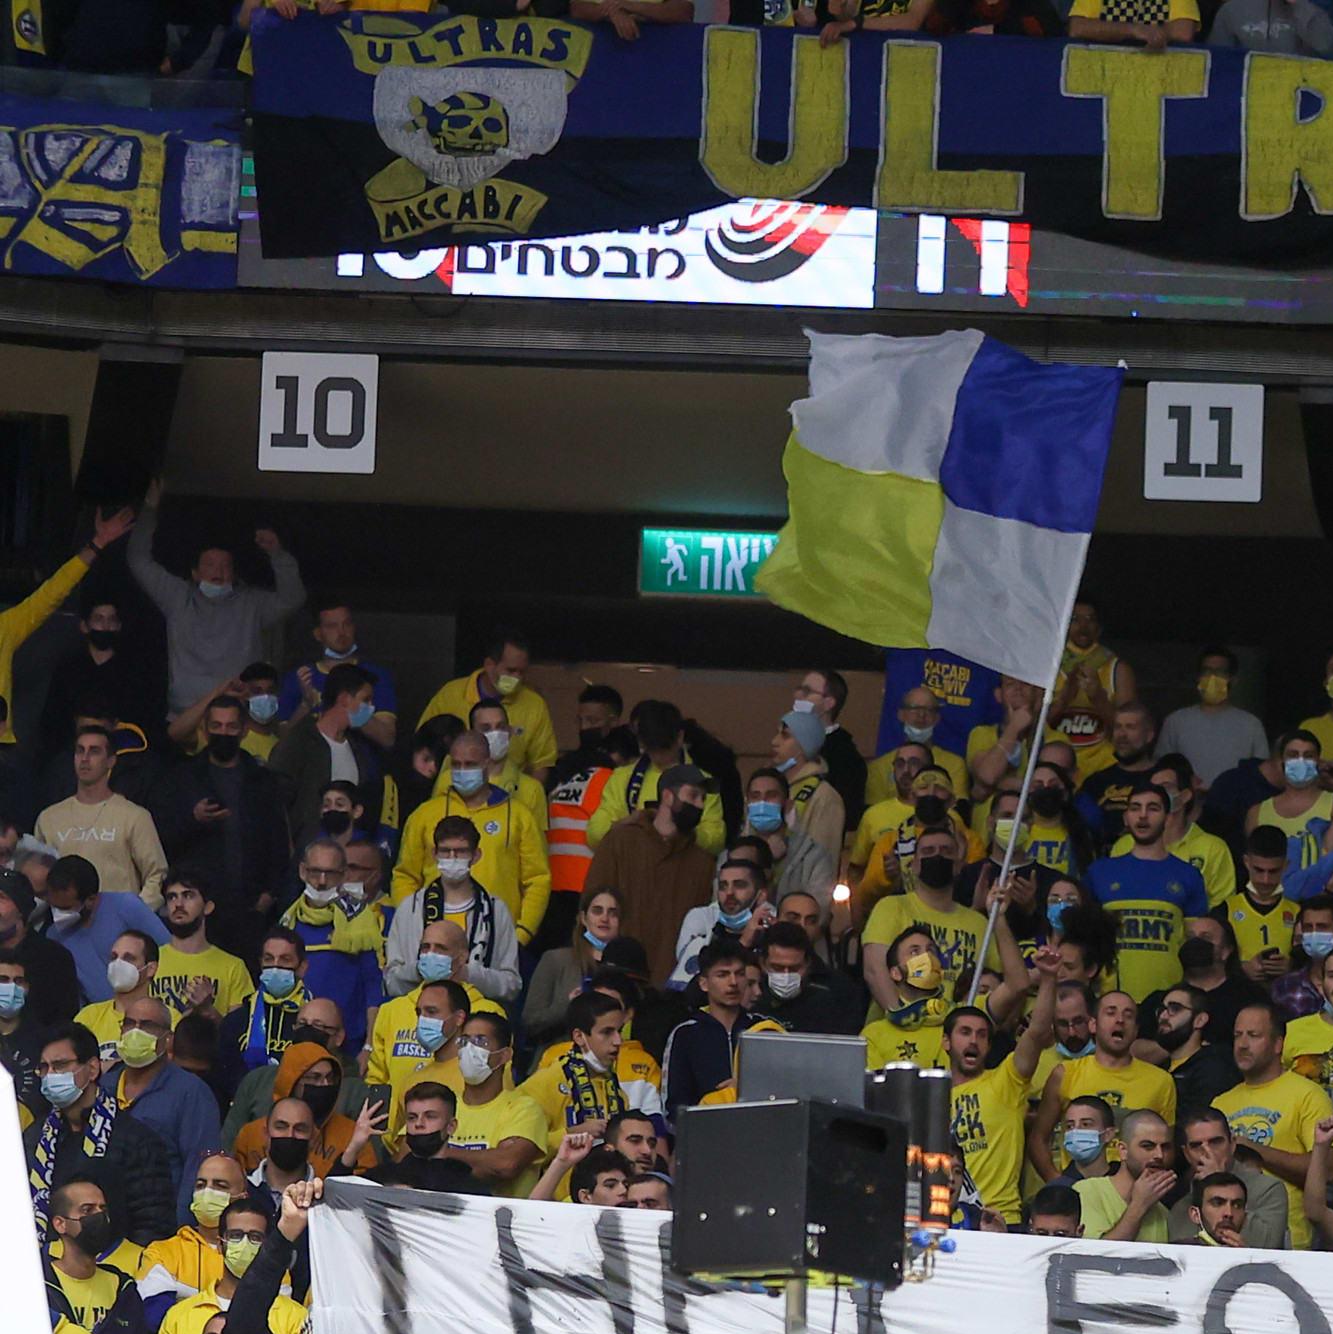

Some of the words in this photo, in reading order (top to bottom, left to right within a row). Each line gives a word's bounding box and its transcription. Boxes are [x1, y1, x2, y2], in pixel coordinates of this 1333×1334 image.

[366, 16, 573, 65] ULTRAS
[381, 190, 524, 240] MACCABI
[456, 241, 687, 282] מבטחים
[270, 374, 367, 450] 10
[1162, 405, 1244, 479] 11
[952, 929, 977, 948] I'M
[1259, 925, 1269, 945] 1
